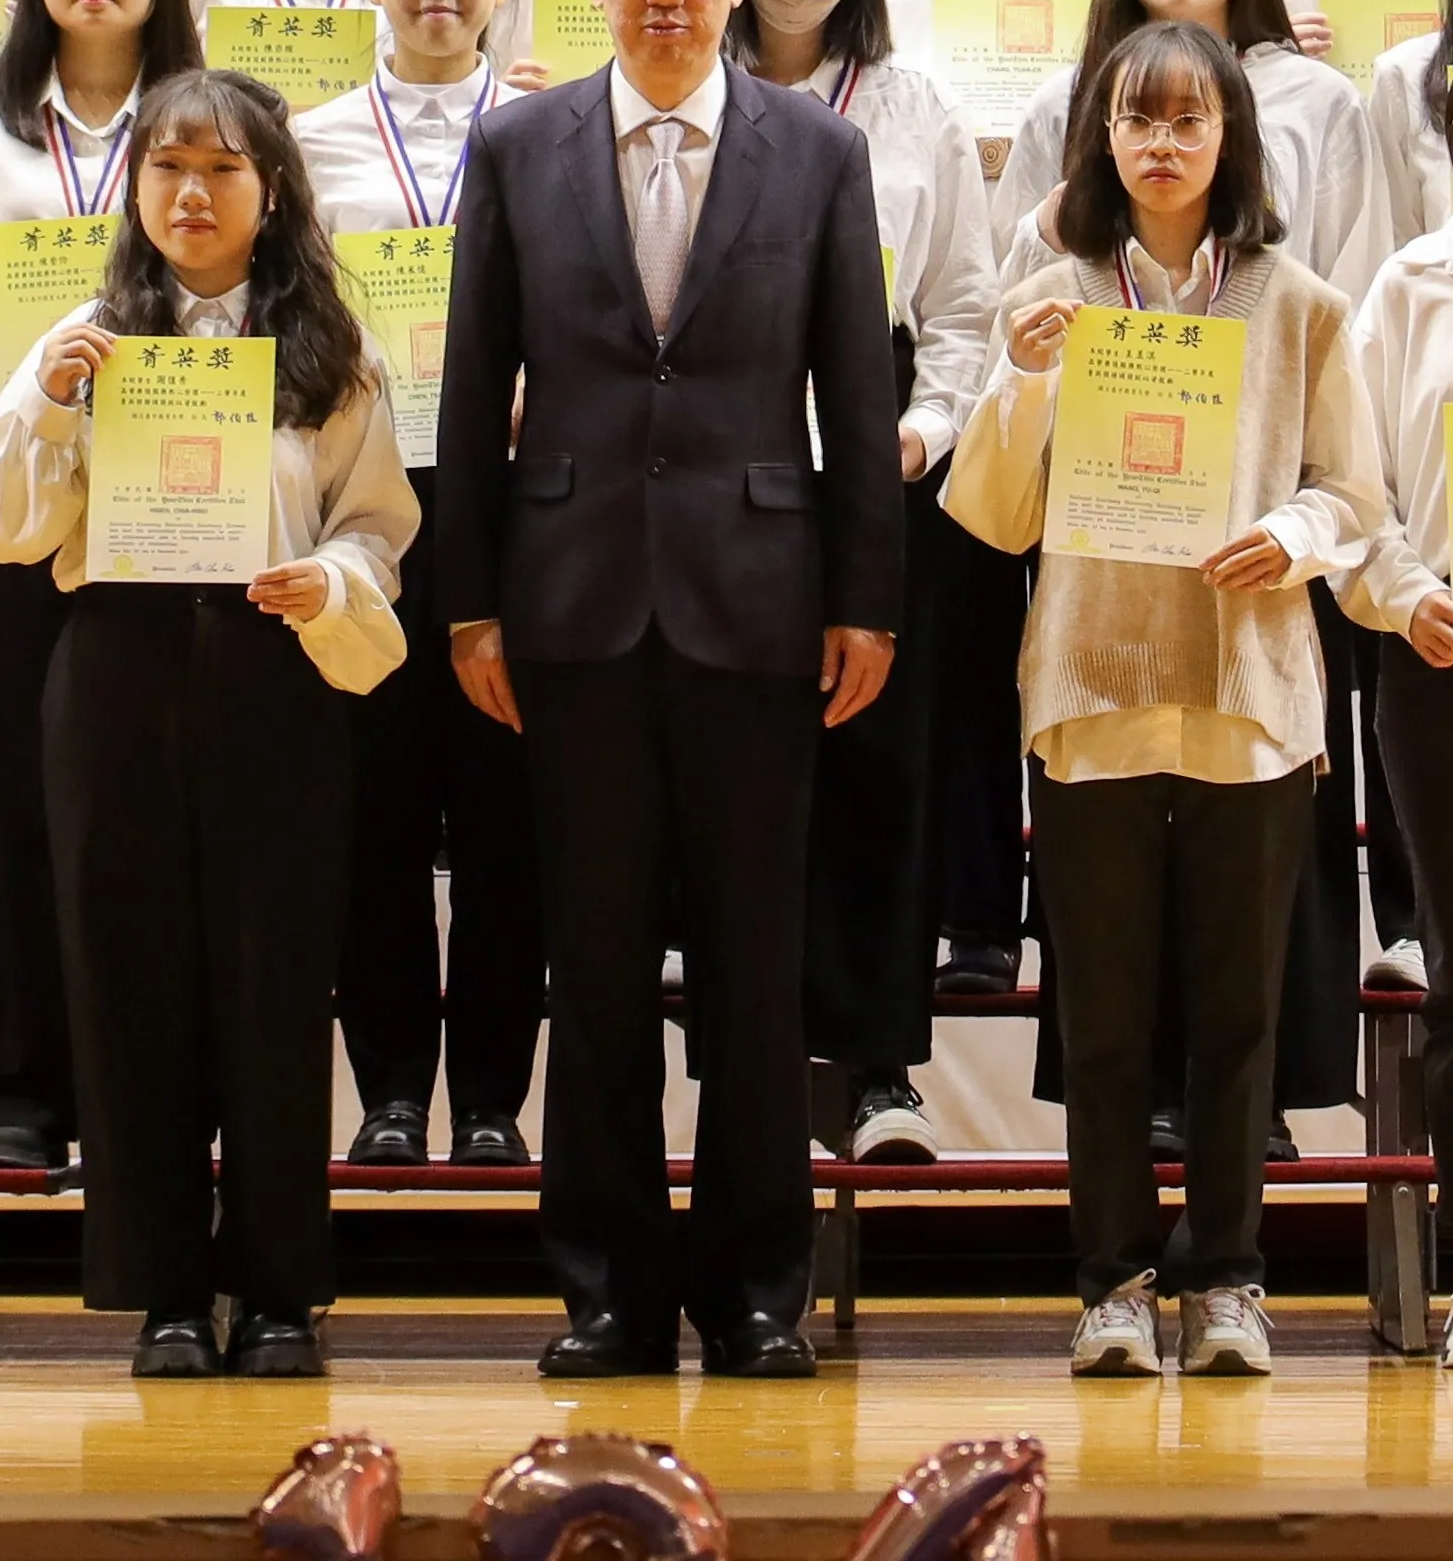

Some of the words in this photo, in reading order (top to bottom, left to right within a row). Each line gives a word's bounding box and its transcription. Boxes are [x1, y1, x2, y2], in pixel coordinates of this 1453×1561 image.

[246, 13, 337, 38] 菁英獎
[20, 224, 109, 252] 菁英獎
[1107, 316, 1203, 348] 菁英獎
[138, 344, 233, 370] 菁英獎
